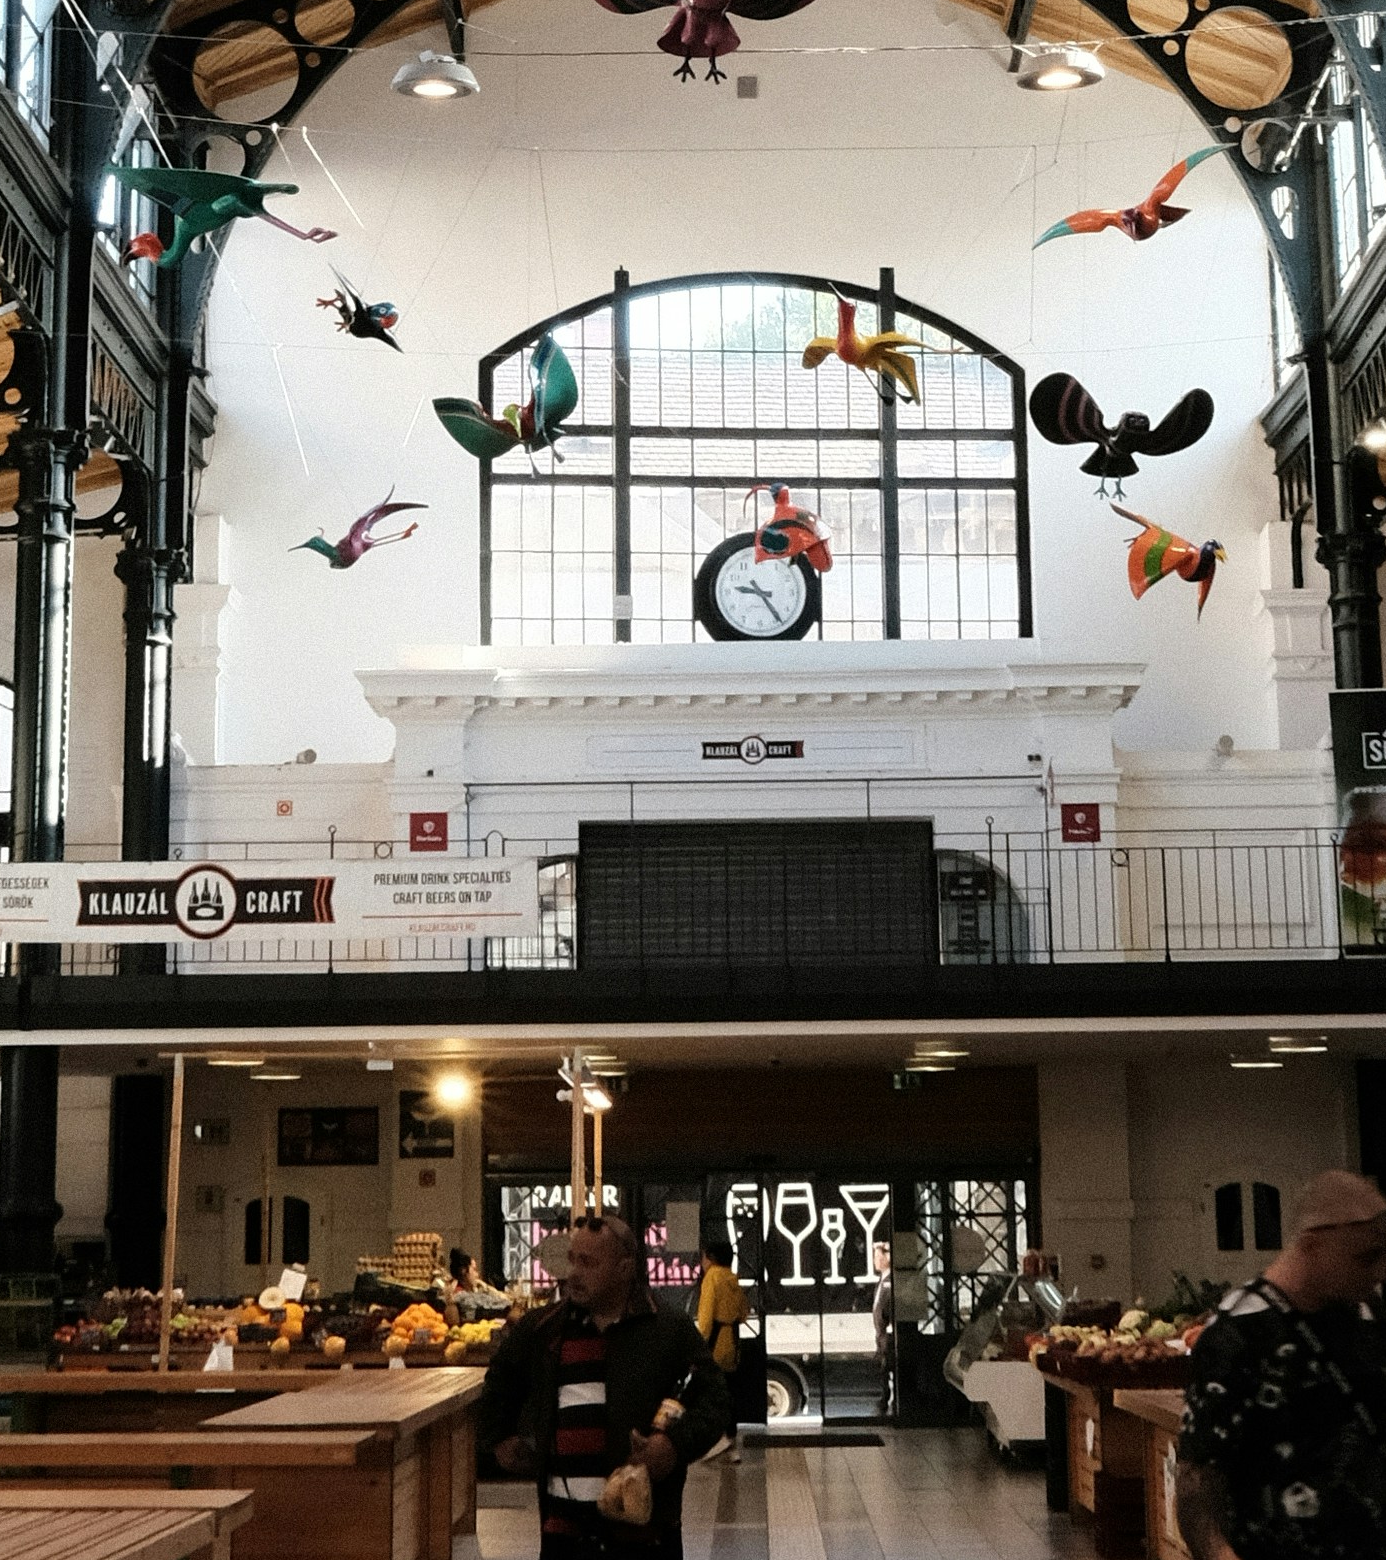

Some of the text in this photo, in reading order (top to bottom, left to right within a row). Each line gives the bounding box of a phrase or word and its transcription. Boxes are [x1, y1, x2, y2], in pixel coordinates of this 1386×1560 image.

[373, 870, 512, 886] PREMIUM DRINK SPECIALTIES
[88, 884, 303, 916] KLAUZÁL CRAFT
[392, 890, 493, 905] CRAFT BEERS ON TAP
